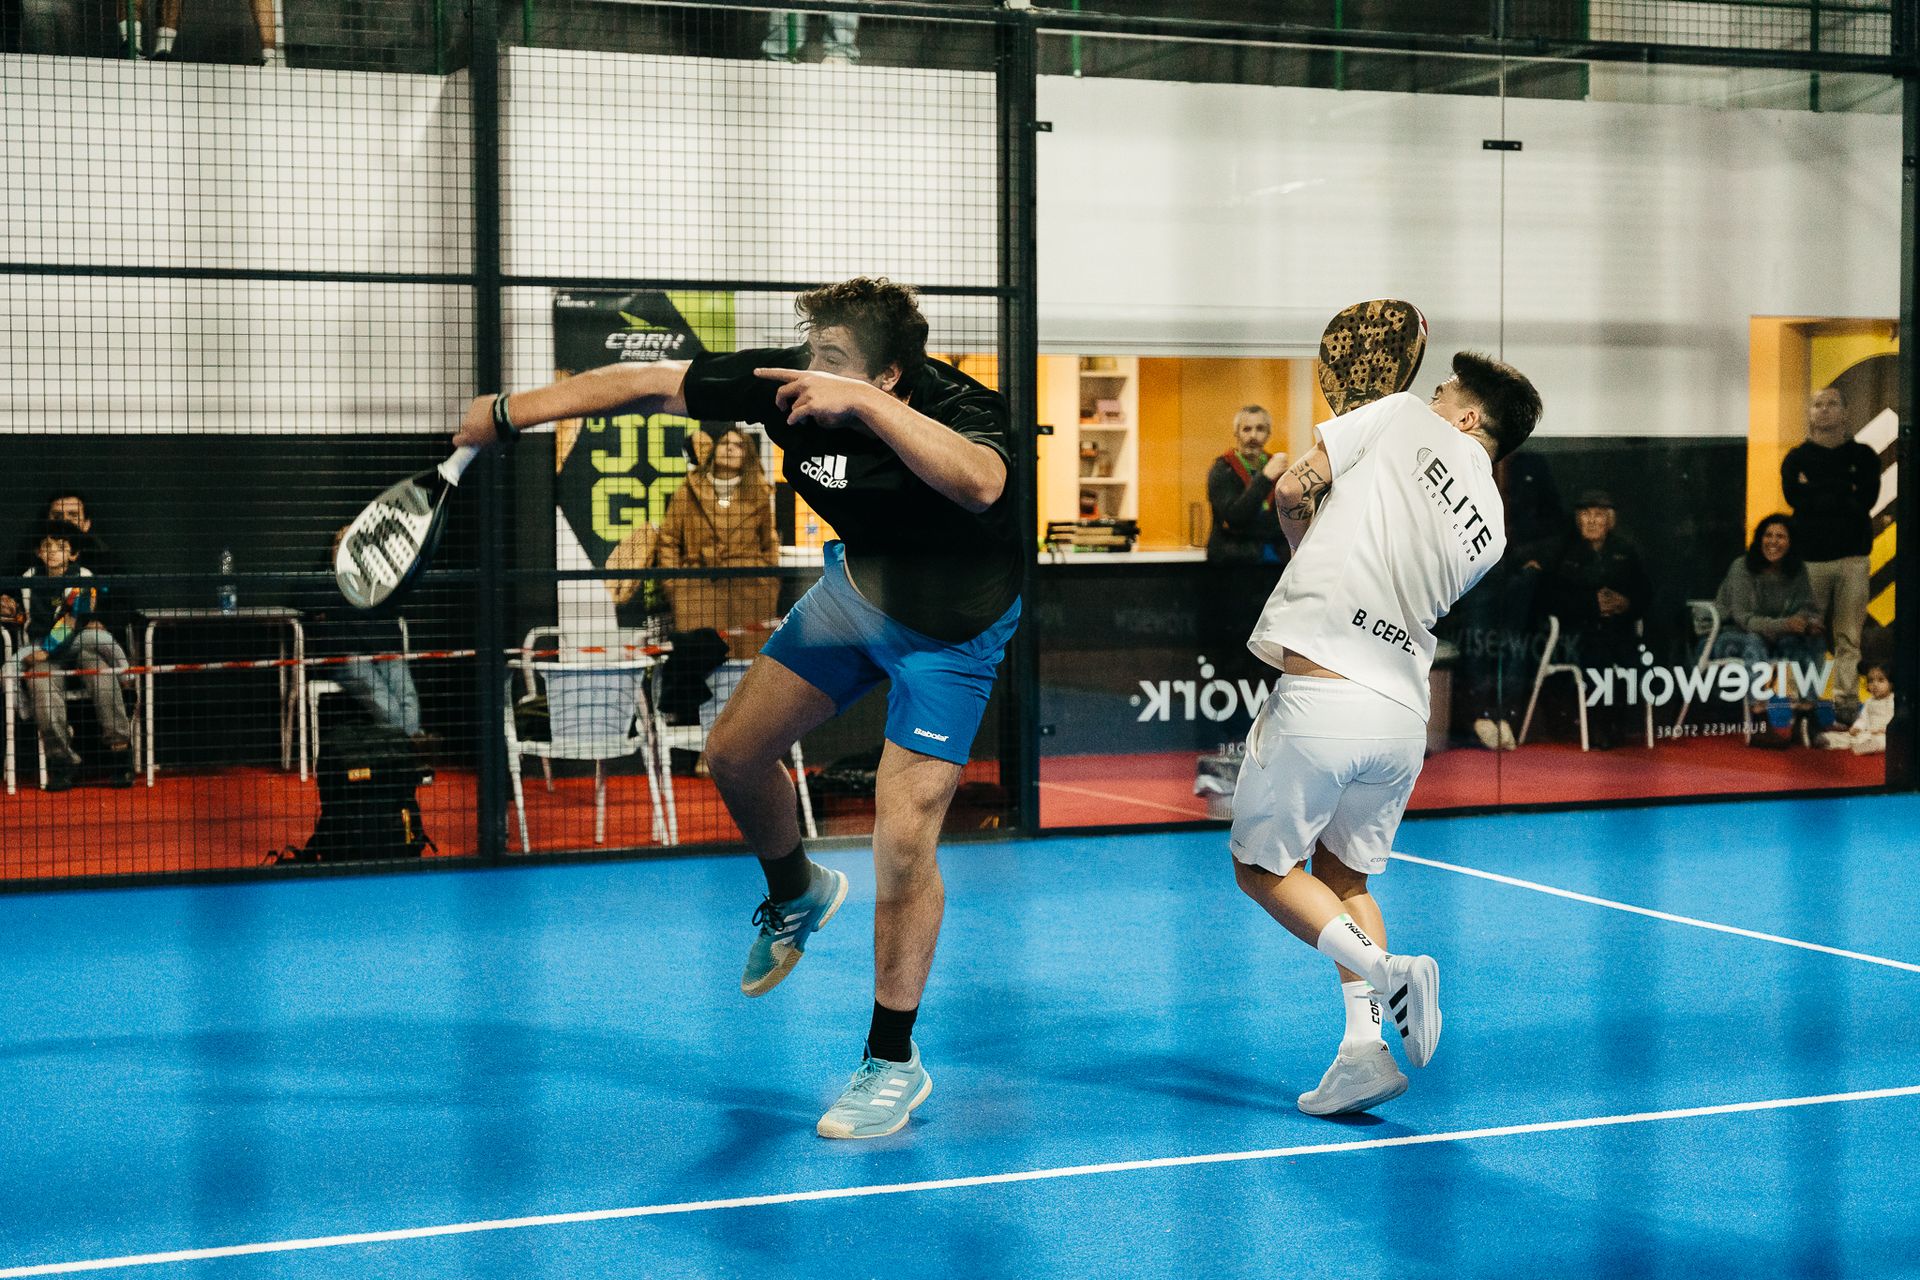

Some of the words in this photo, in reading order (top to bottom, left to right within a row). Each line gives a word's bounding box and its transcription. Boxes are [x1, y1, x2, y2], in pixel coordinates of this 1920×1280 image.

[605, 332, 685, 350] CORK
[620, 350, 668, 360] PADEL
[800, 461, 848, 489] adidas
[1423, 457, 1492, 554] ELITE
[1352, 608, 1367, 630] B.
[1372, 619, 1416, 657] CEPE
[913, 727, 949, 742] Babolat
[1345, 922, 1372, 946] CORK
